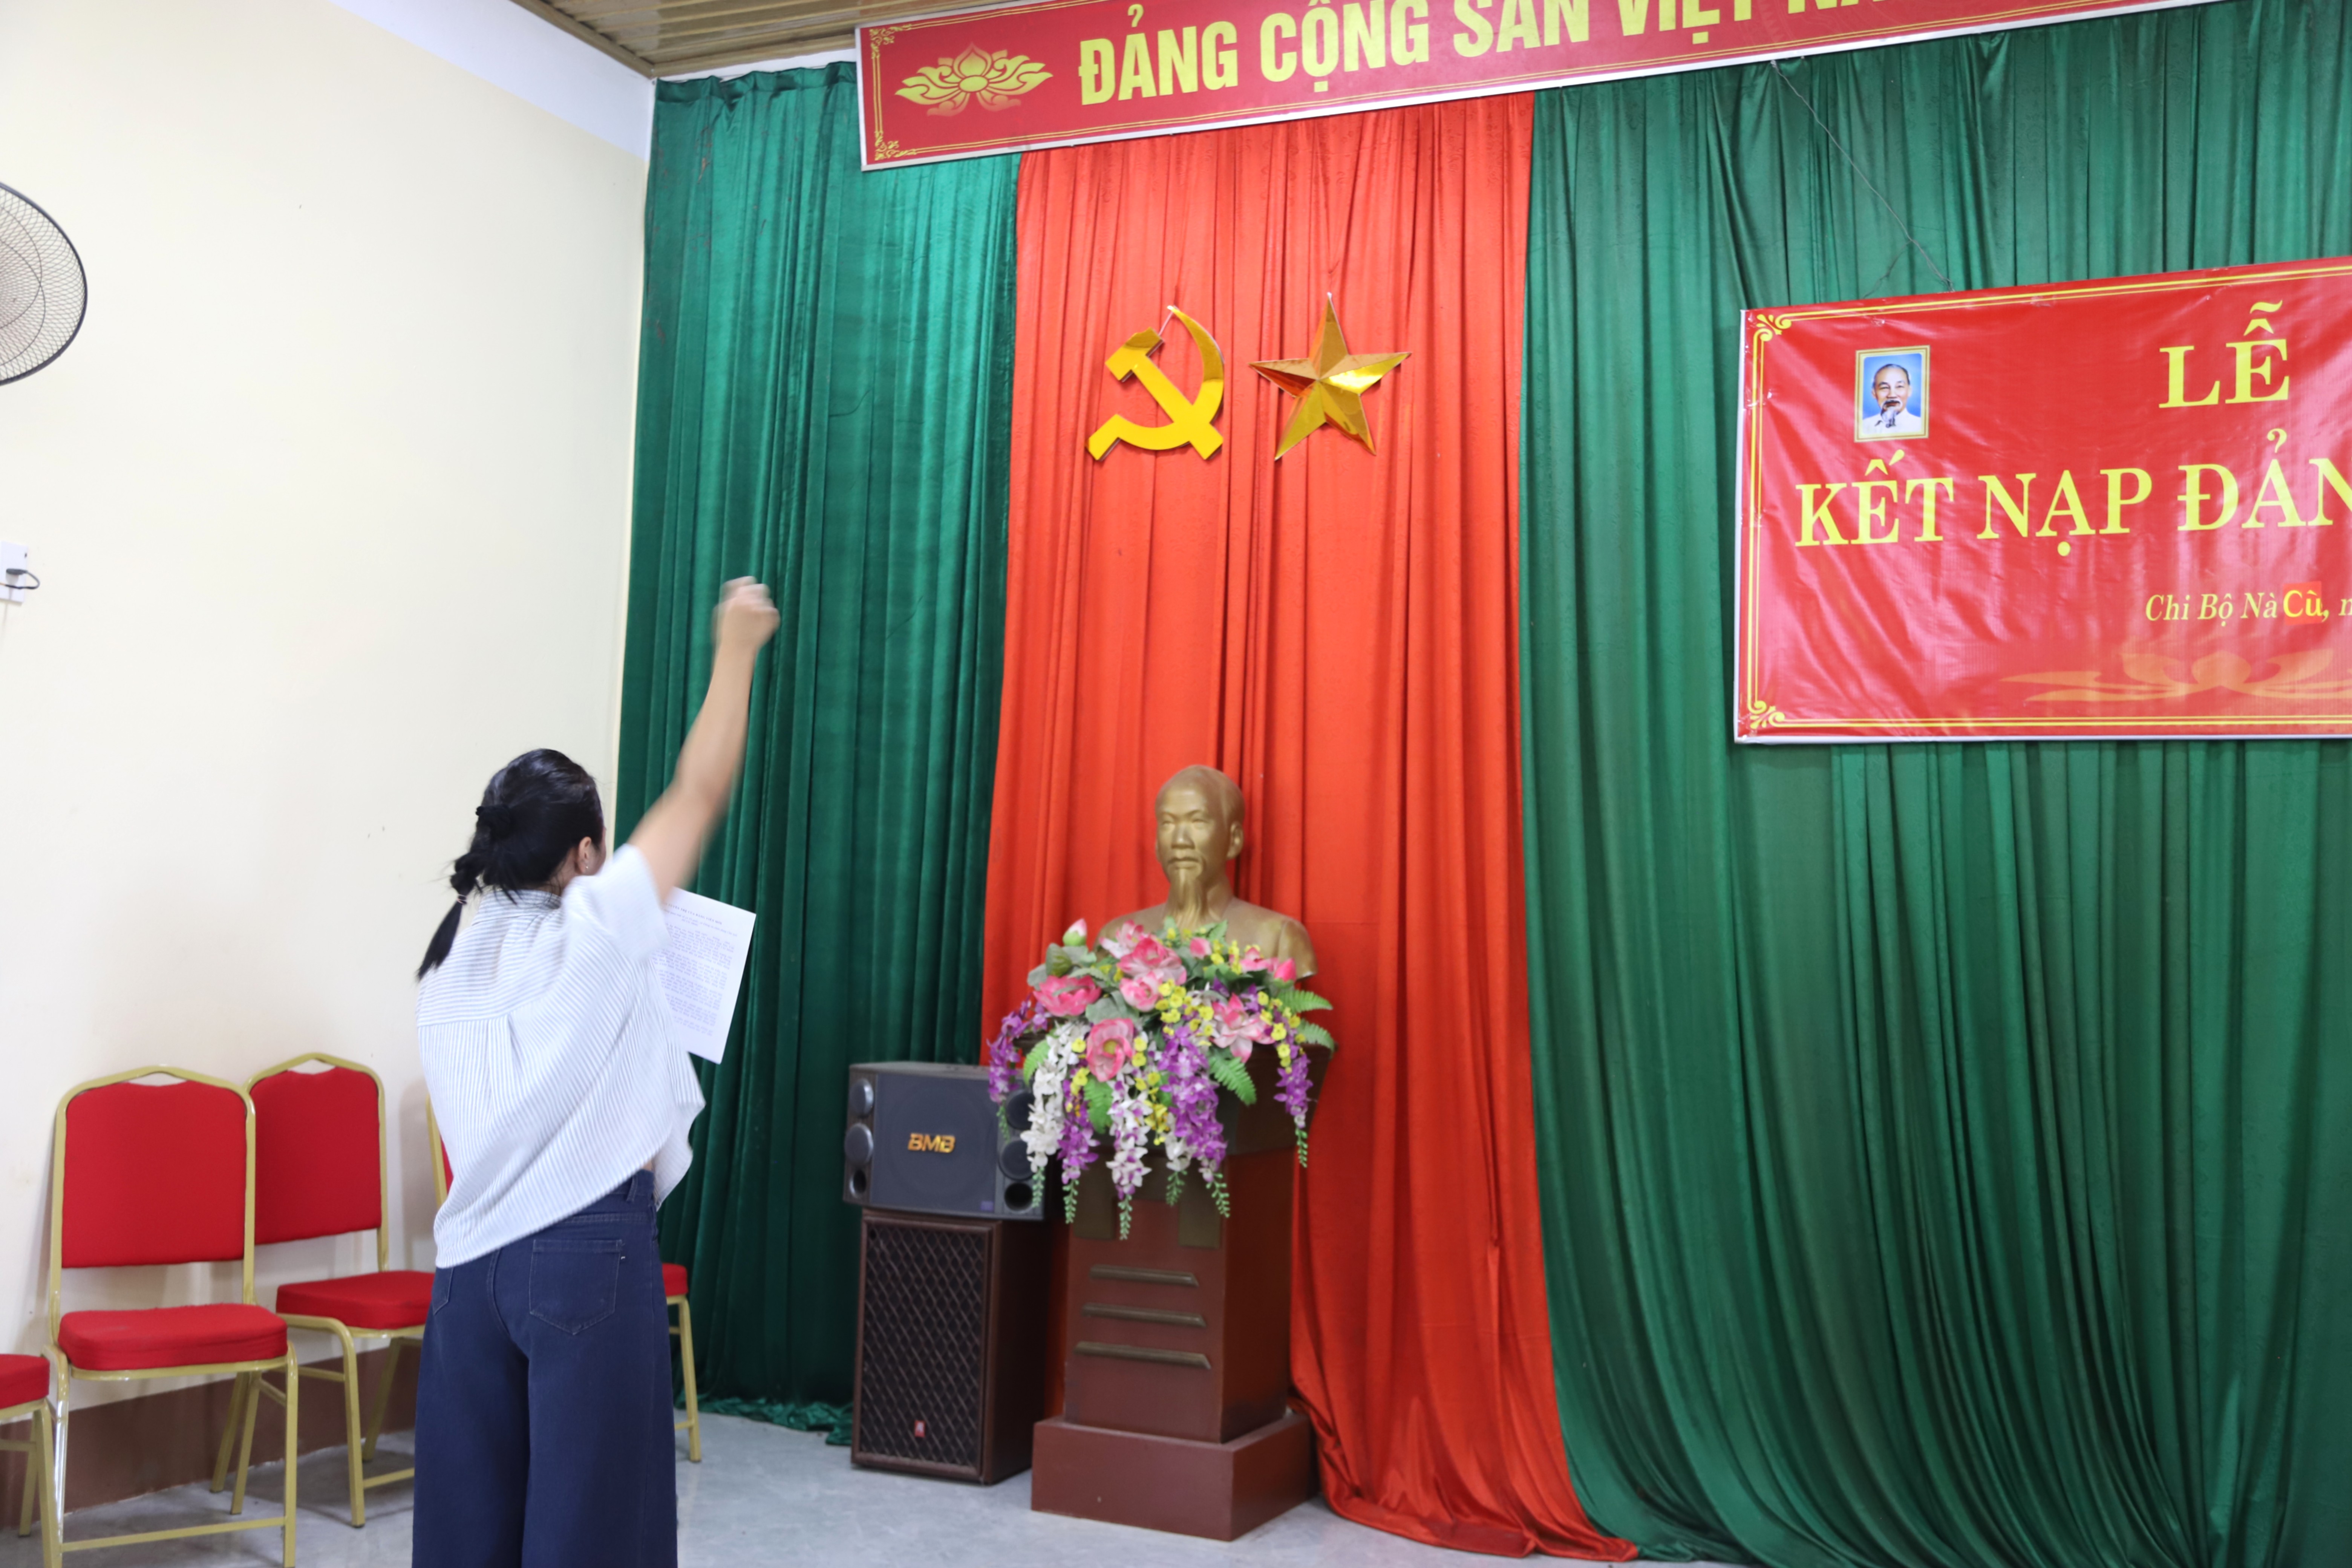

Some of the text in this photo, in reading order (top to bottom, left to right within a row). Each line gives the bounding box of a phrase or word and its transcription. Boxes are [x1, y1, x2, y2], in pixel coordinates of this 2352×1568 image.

[1078, 4, 1238, 105] ĐẢNG
[1260, 0, 1429, 92] CỘNG
[2159, 300, 2290, 408] LỄ
[1795, 449, 1954, 547] KẾT
[1977, 468, 2152, 556] NẠP
[2145, 594, 2190, 621] Chi
[2197, 593, 2234, 627] Bộ
[2240, 592, 2277, 619] Nà
[908, 1133, 956, 1153] BMB
